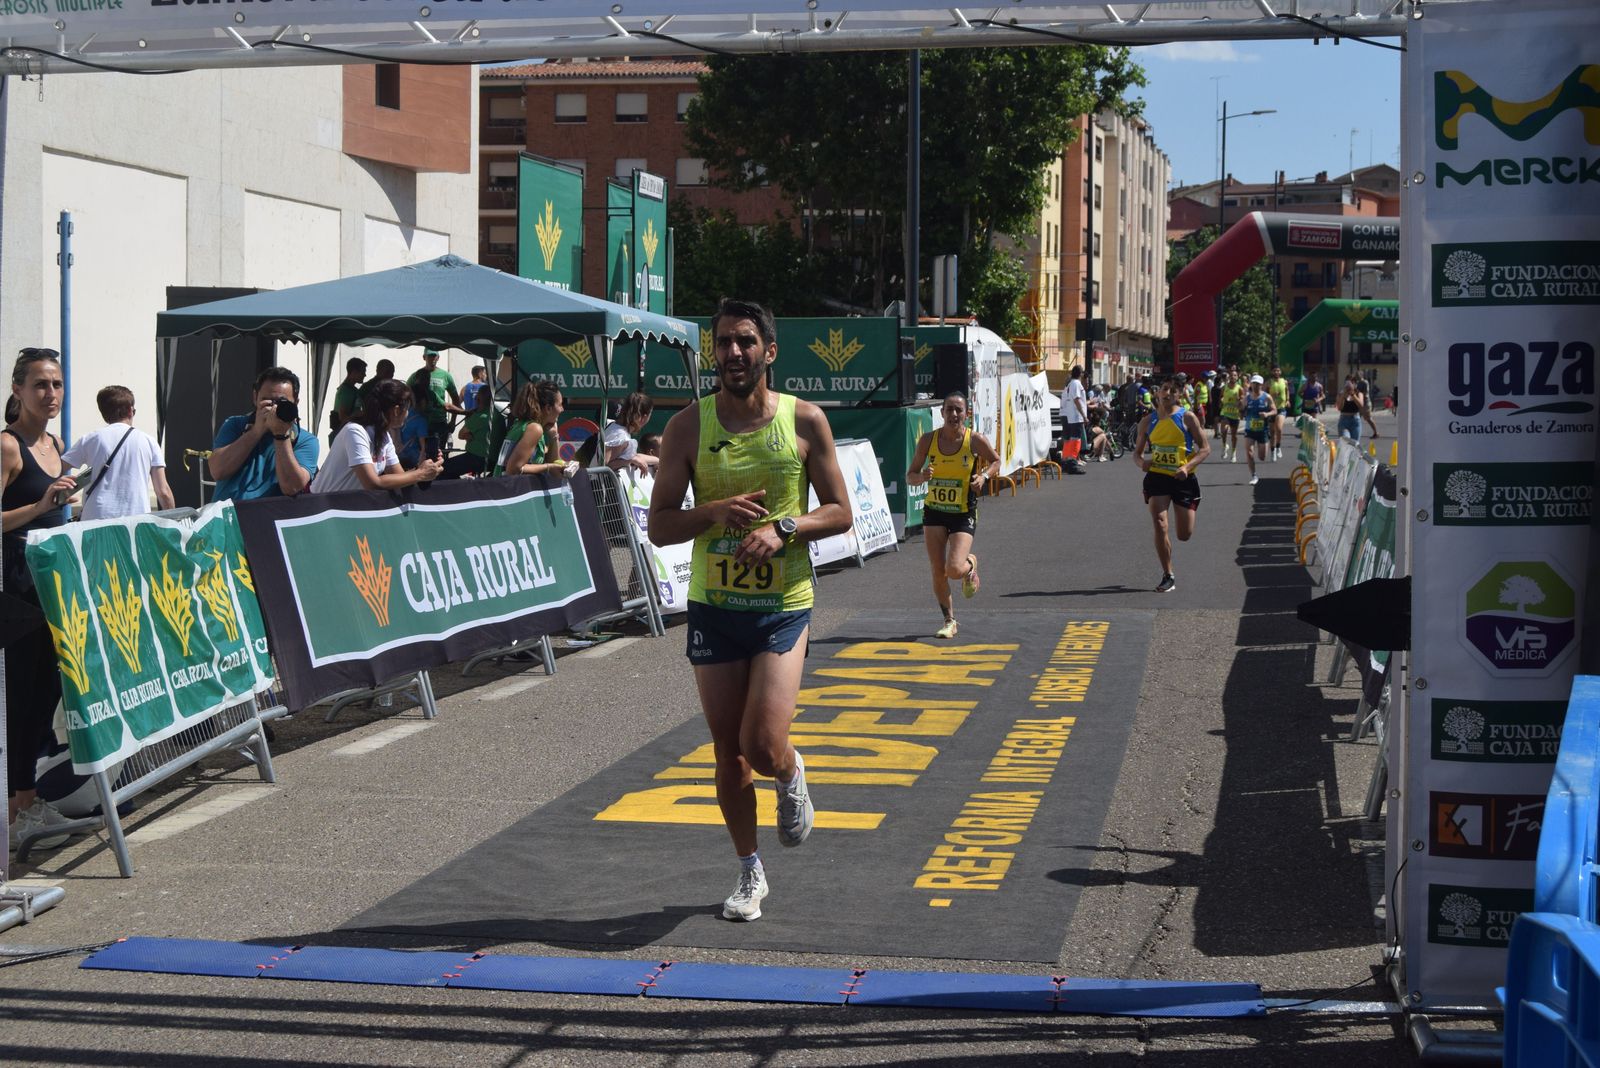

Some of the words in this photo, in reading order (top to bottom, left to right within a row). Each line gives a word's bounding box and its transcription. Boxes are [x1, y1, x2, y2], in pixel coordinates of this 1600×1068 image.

[1352, 224, 1380, 236] CON
[1383, 225, 1398, 236] EL
[1300, 235, 1338, 245] ZAMORA
[1490, 265, 1600, 281] FUNDACION
[1490, 283, 1538, 299] CAJA
[1542, 282, 1600, 297] RURAL
[785, 377, 826, 392] CAJA
[830, 376, 889, 392] RURAL
[1448, 341, 1595, 417] gaza
[1448, 421, 1522, 435] Ganaderos
[1526, 421, 1543, 434] de
[1546, 420, 1595, 434] Zamora
[1154, 452, 1176, 464] 245
[931, 488, 957, 503] 160
[1491, 502, 1538, 519] CAJA
[855, 508, 892, 541] OCEANIC
[400, 550, 472, 613] CAJA
[467, 535, 556, 600] RURAL
[715, 559, 773, 590] 129
[727, 596, 748, 606] CAJA
[749, 598, 779, 607] RURAL
[120, 688, 141, 711] CAJA
[137, 677, 166, 703] RURAL
[1490, 741, 1535, 757] CAJA
[913, 790, 1045, 890] REFORMA
[980, 716, 1077, 783] INTEGRAL
